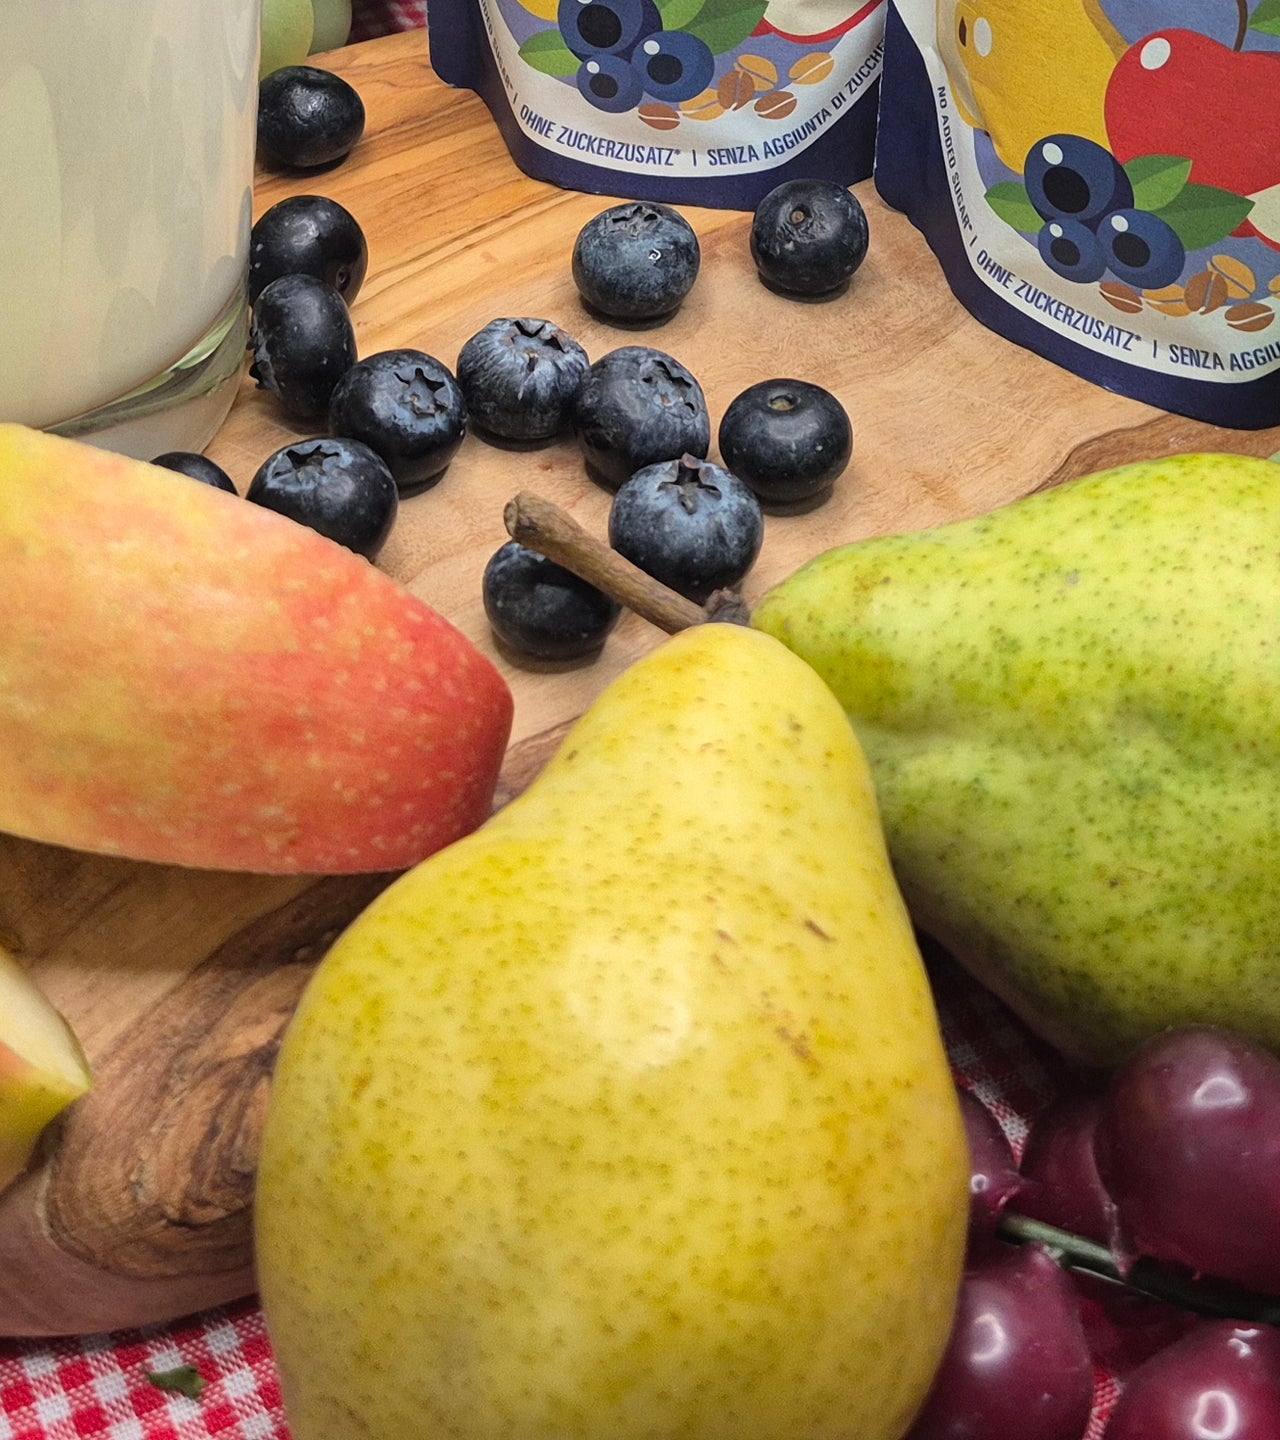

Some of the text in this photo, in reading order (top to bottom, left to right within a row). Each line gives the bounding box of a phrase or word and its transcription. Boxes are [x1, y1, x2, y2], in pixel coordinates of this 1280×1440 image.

[936, 86, 948, 109] NO
[520, 104, 557, 138] OHNE
[708, 144, 760, 166] SENZA
[762, 107, 832, 159] AGGIUNTA
[830, 91, 848, 110] DI
[940, 114, 958, 170] ADDED
[975, 249, 1016, 290] OHNE
[1168, 344, 1225, 371] SENZA
